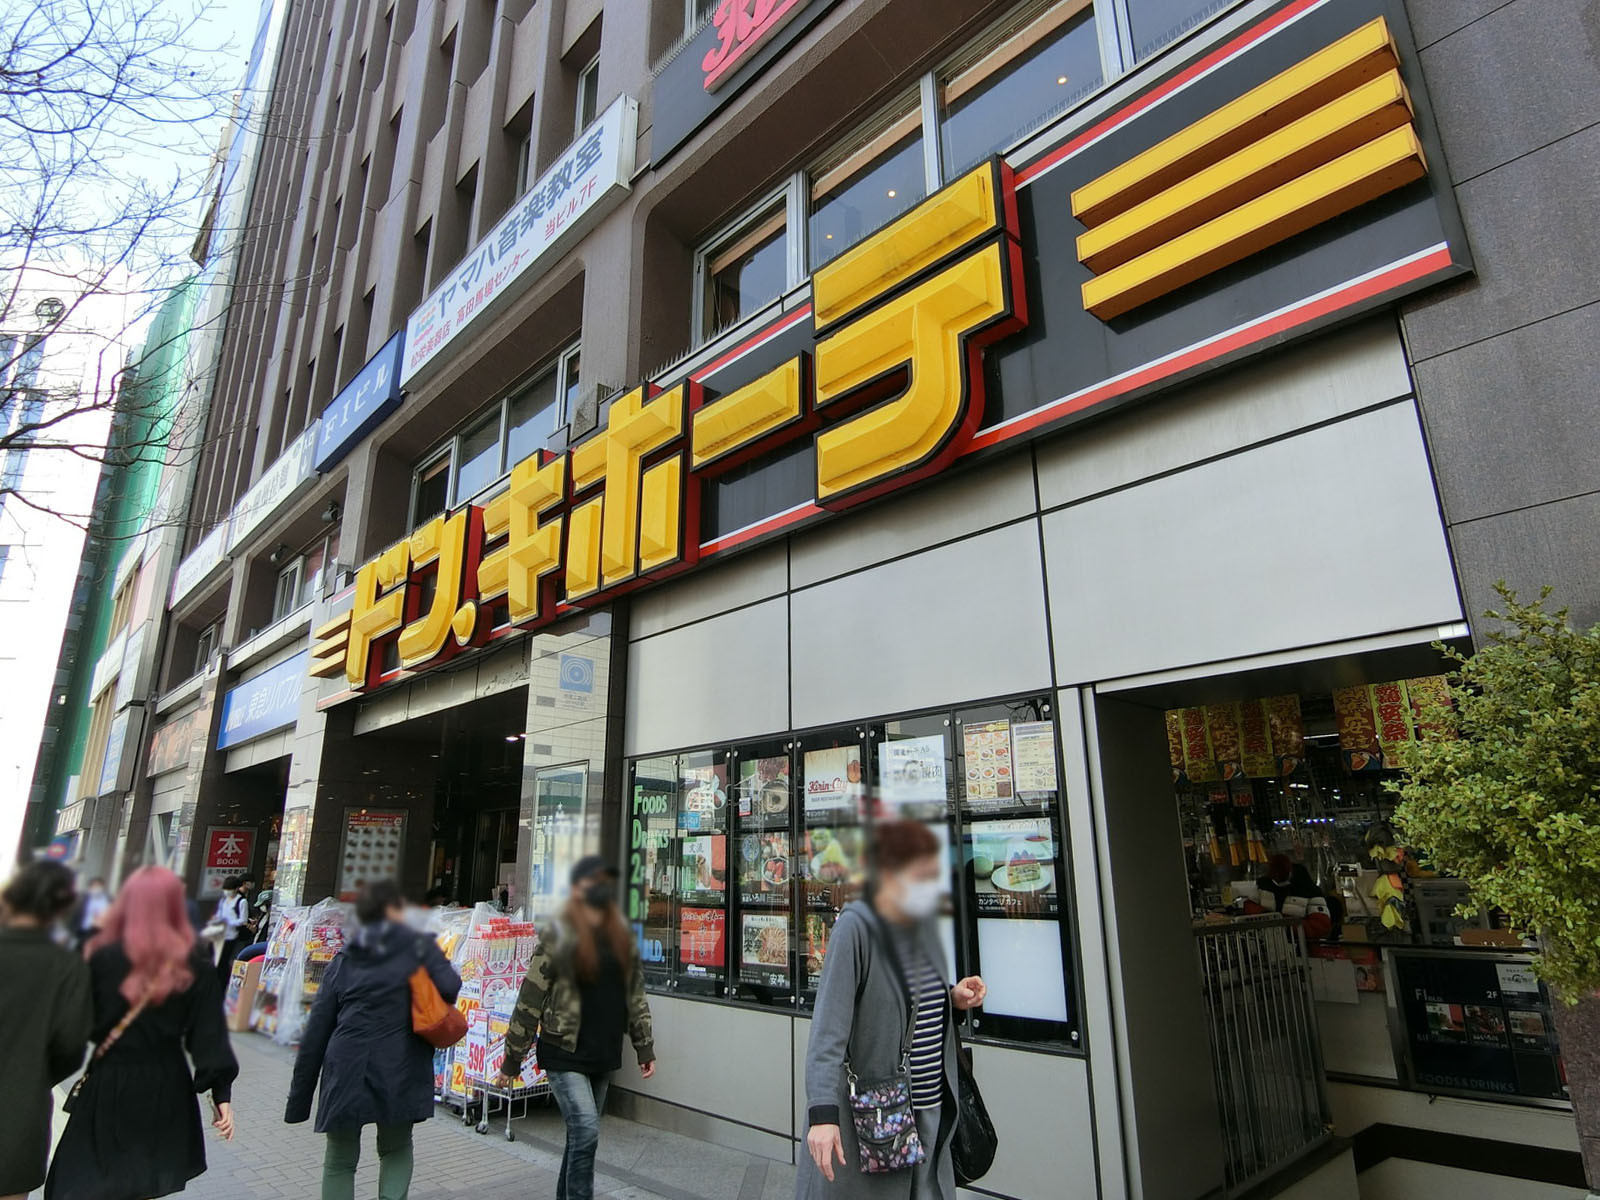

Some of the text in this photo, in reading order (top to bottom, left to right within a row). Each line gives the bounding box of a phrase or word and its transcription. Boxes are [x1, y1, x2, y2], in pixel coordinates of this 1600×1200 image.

[439, 126, 604, 318] ヤマハ音楽教室
[217, 833, 244, 857] 本
[468, 1042, 486, 1073] 598
